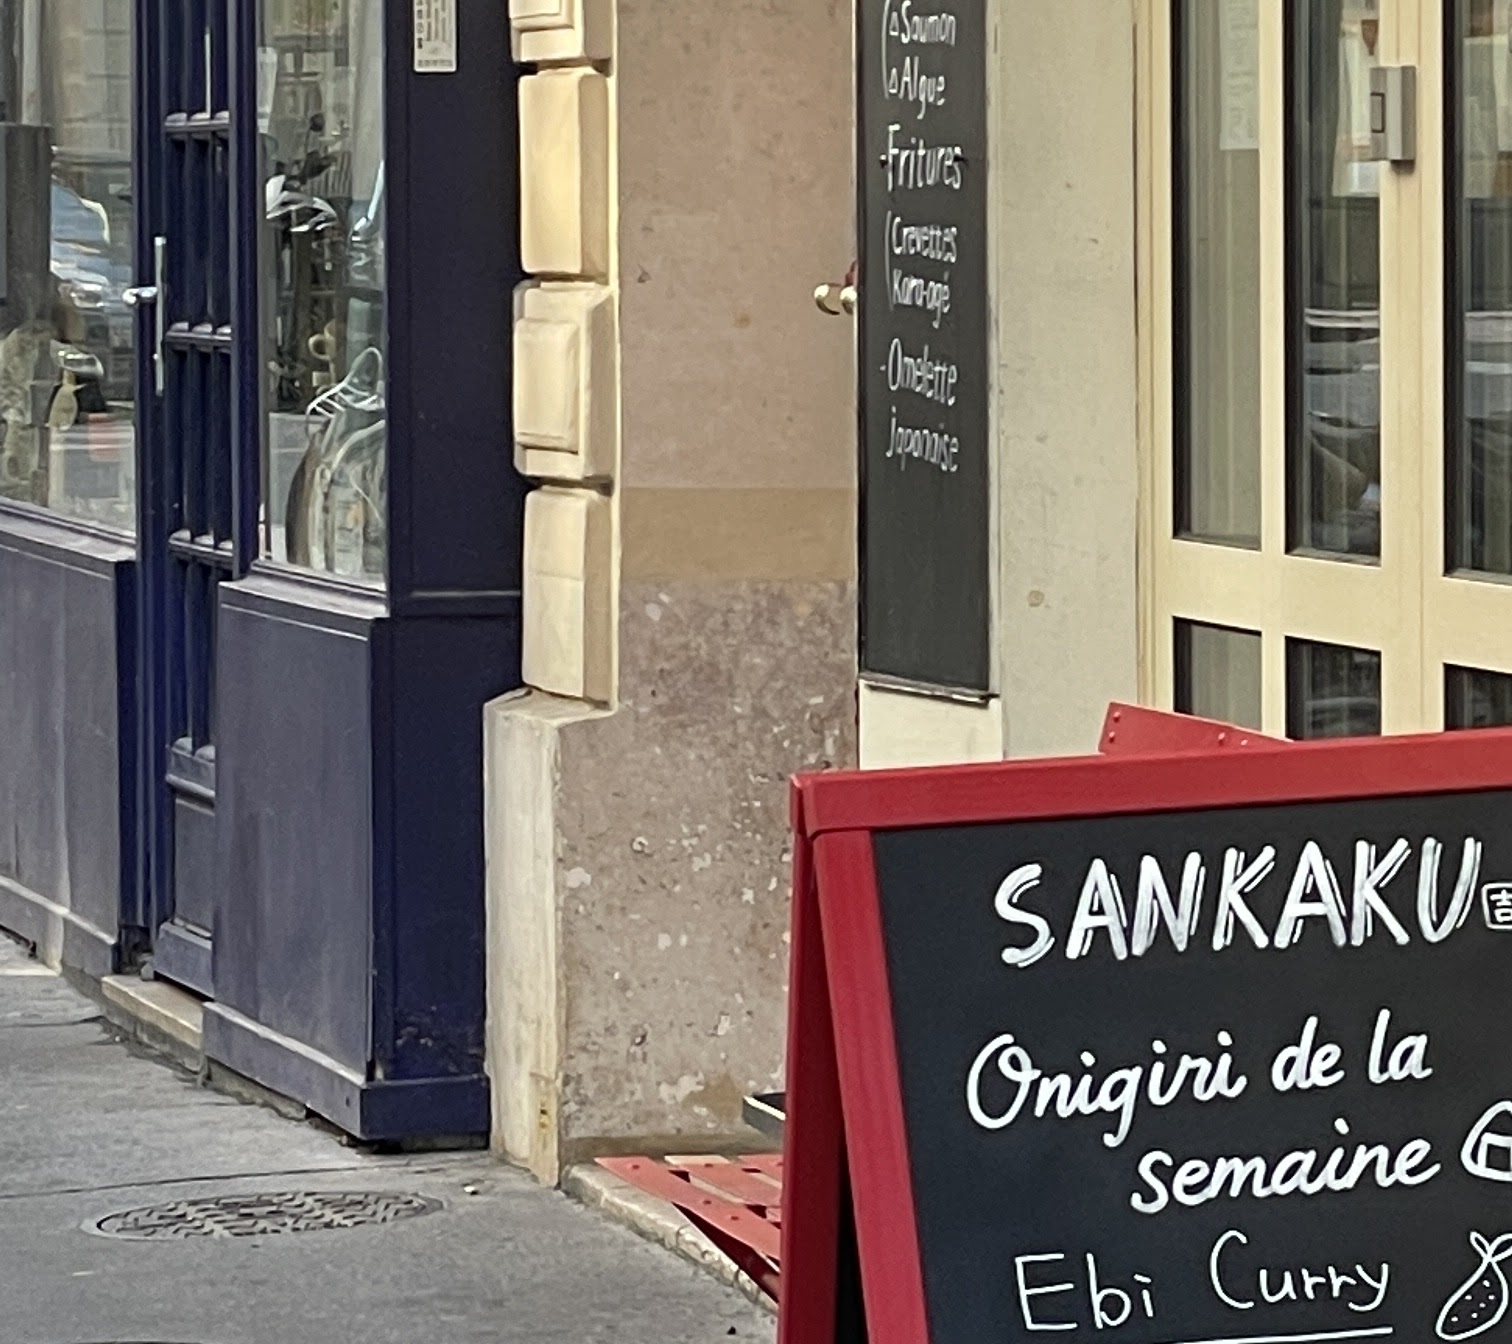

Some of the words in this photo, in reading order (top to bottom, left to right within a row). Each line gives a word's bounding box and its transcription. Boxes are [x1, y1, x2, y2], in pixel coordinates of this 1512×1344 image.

[900, 0, 956, 46] Saumon
[899, 56, 946, 120] Algue
[892, 216, 957, 263] Crevettes
[994, 835, 1484, 969] SANKAKU
[966, 1030, 1248, 1149] Onigiri
[1270, 1015, 1345, 1095] de
[1368, 1007, 1433, 1086] la
[1129, 1117, 1442, 1216] semaine
[1014, 1252, 1155, 1332] Ebi
[1209, 1230, 1391, 1312] Curry
